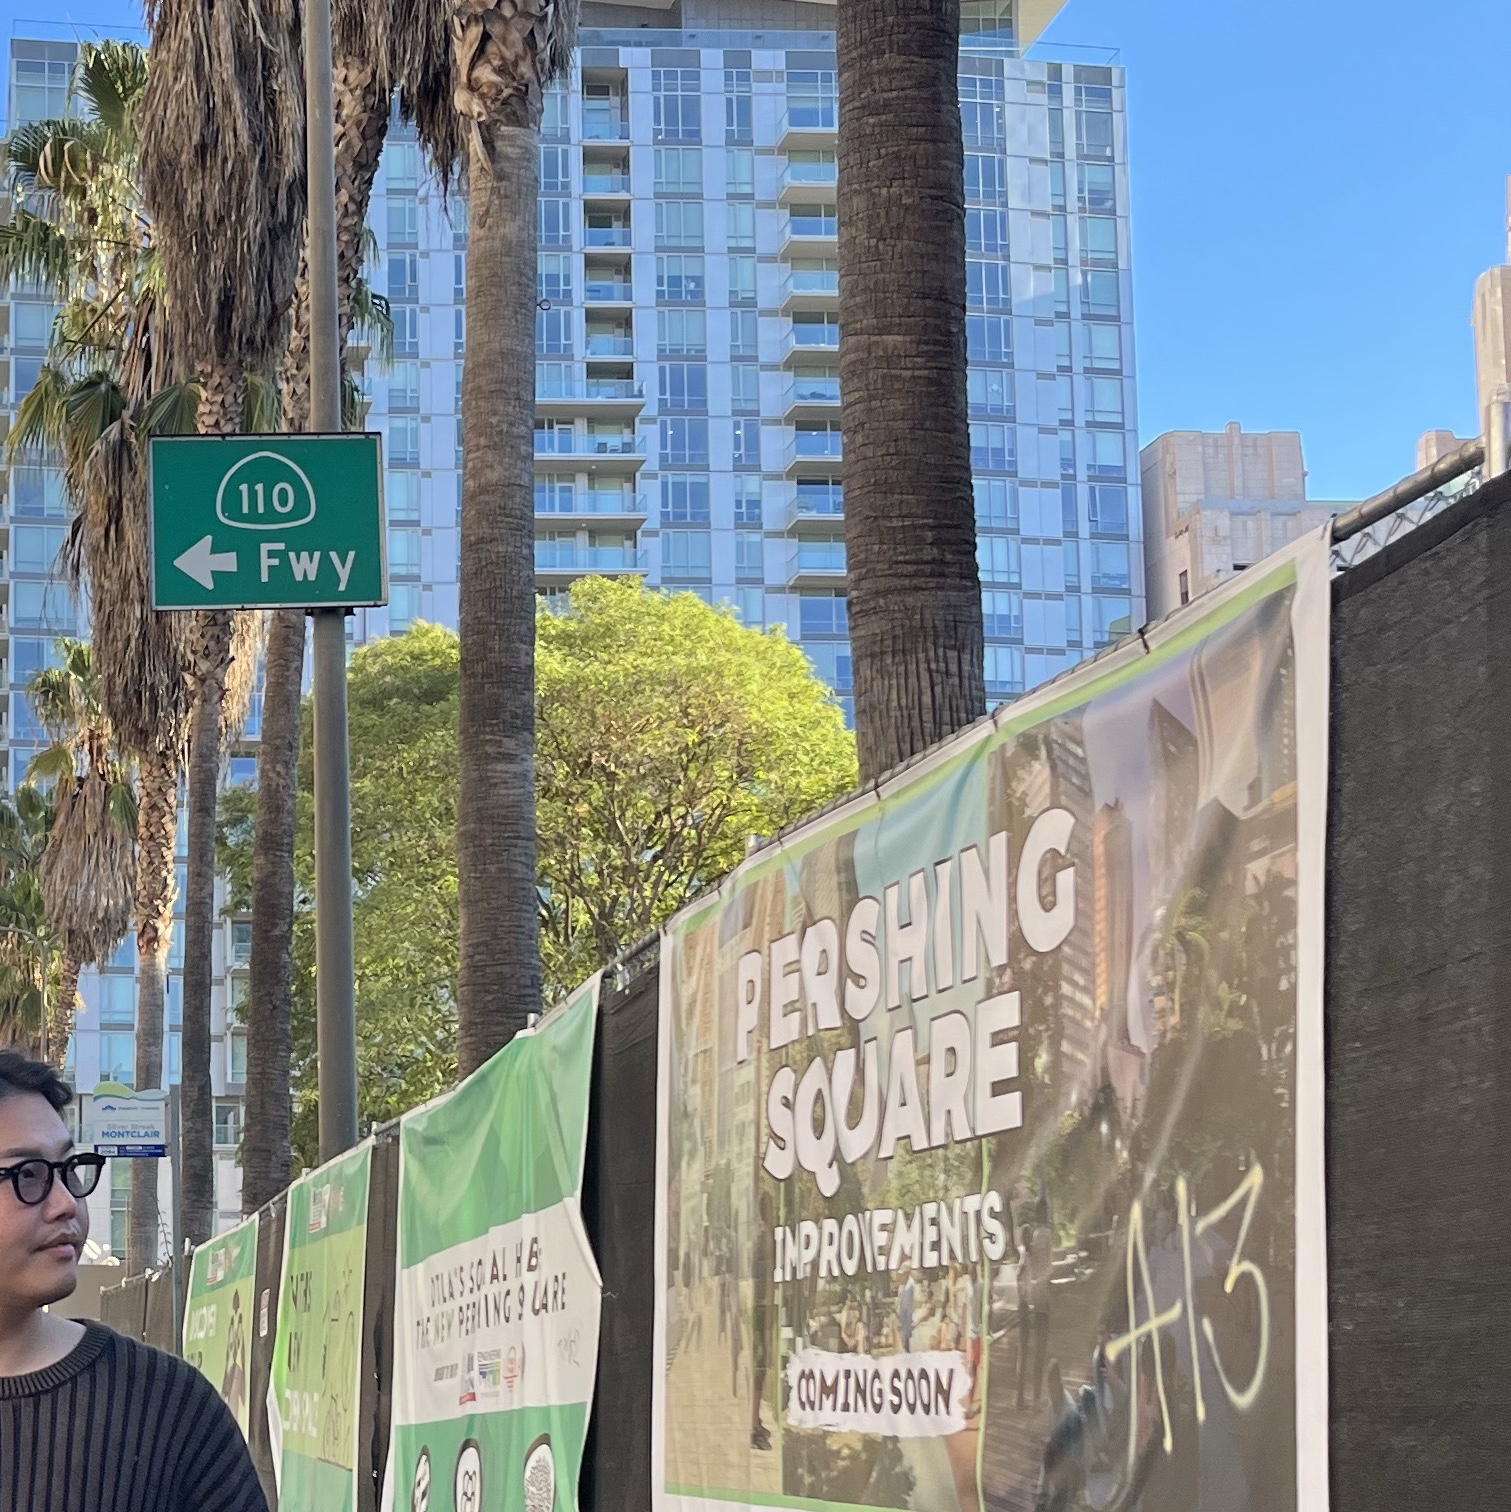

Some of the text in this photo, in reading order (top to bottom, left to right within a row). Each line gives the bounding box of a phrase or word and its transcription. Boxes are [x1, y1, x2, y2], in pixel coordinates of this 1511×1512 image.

[239, 482, 295, 514] 110
[260, 542, 356, 591] Fwy
[736, 808, 1077, 1065] PERSHING
[762, 990, 1023, 1198] SQUARE
[101, 1130, 160, 1138] MONTCLAIR
[772, 1190, 1007, 1283] IMPROVEMENTS
[797, 1367, 955, 1416] COMING SOON
